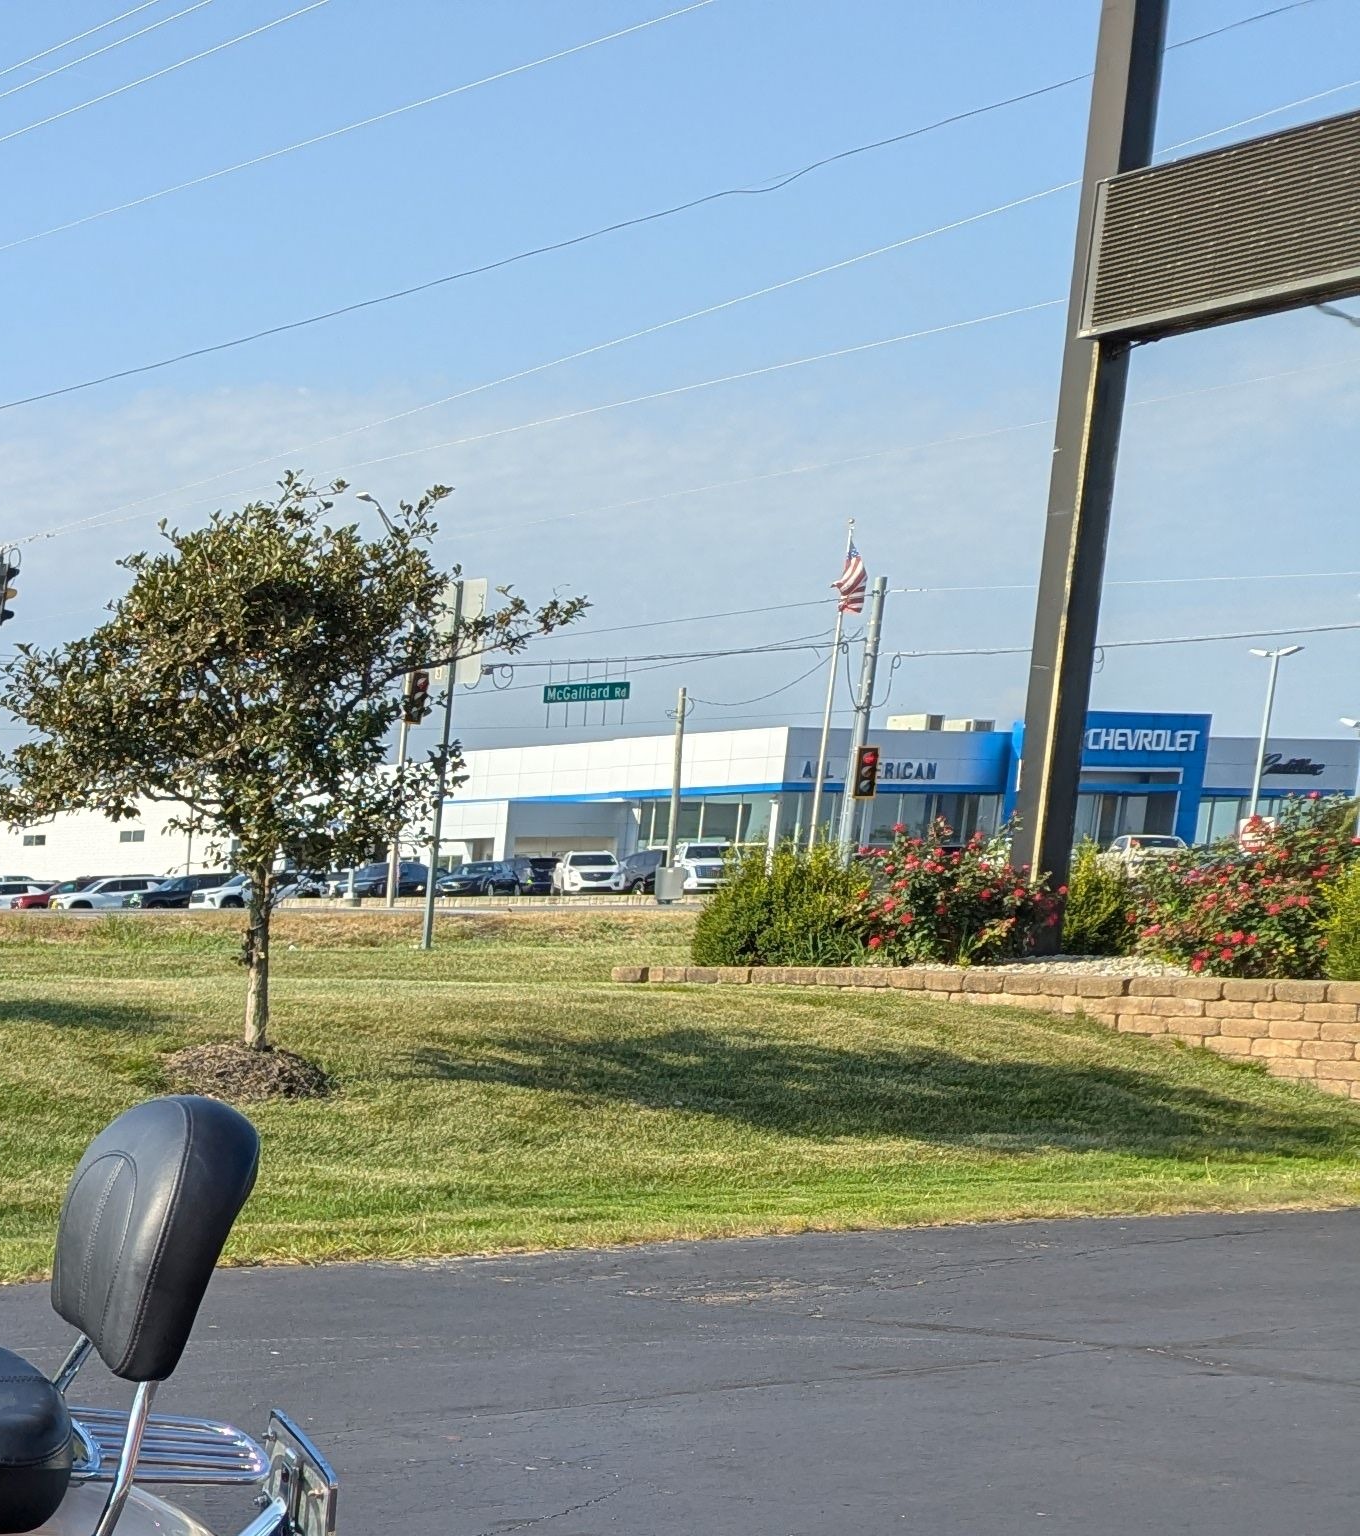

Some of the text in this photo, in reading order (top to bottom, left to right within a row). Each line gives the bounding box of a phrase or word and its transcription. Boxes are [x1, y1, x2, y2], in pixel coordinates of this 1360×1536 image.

[547, 685, 627, 701] McGalliard Rd
[1085, 728, 1200, 752] CHEVROLET
